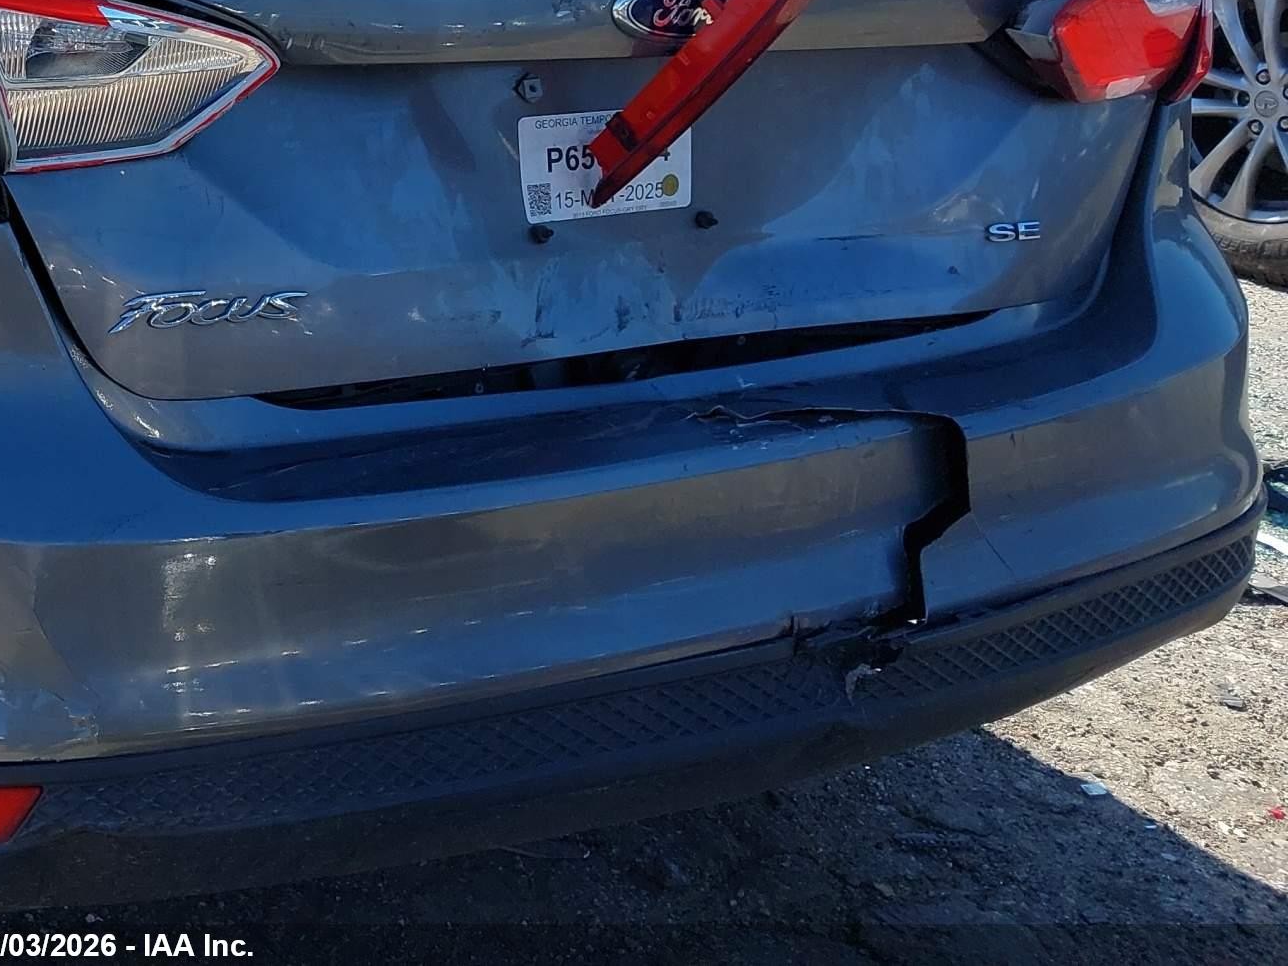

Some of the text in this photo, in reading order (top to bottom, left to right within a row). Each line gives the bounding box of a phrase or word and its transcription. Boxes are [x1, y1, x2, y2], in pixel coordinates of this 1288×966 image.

[535, 113, 611, 130] GEORGIA TEMPO
[555, 182, 664, 209] 15-M-2025
[988, 221, 1041, 242] SE
